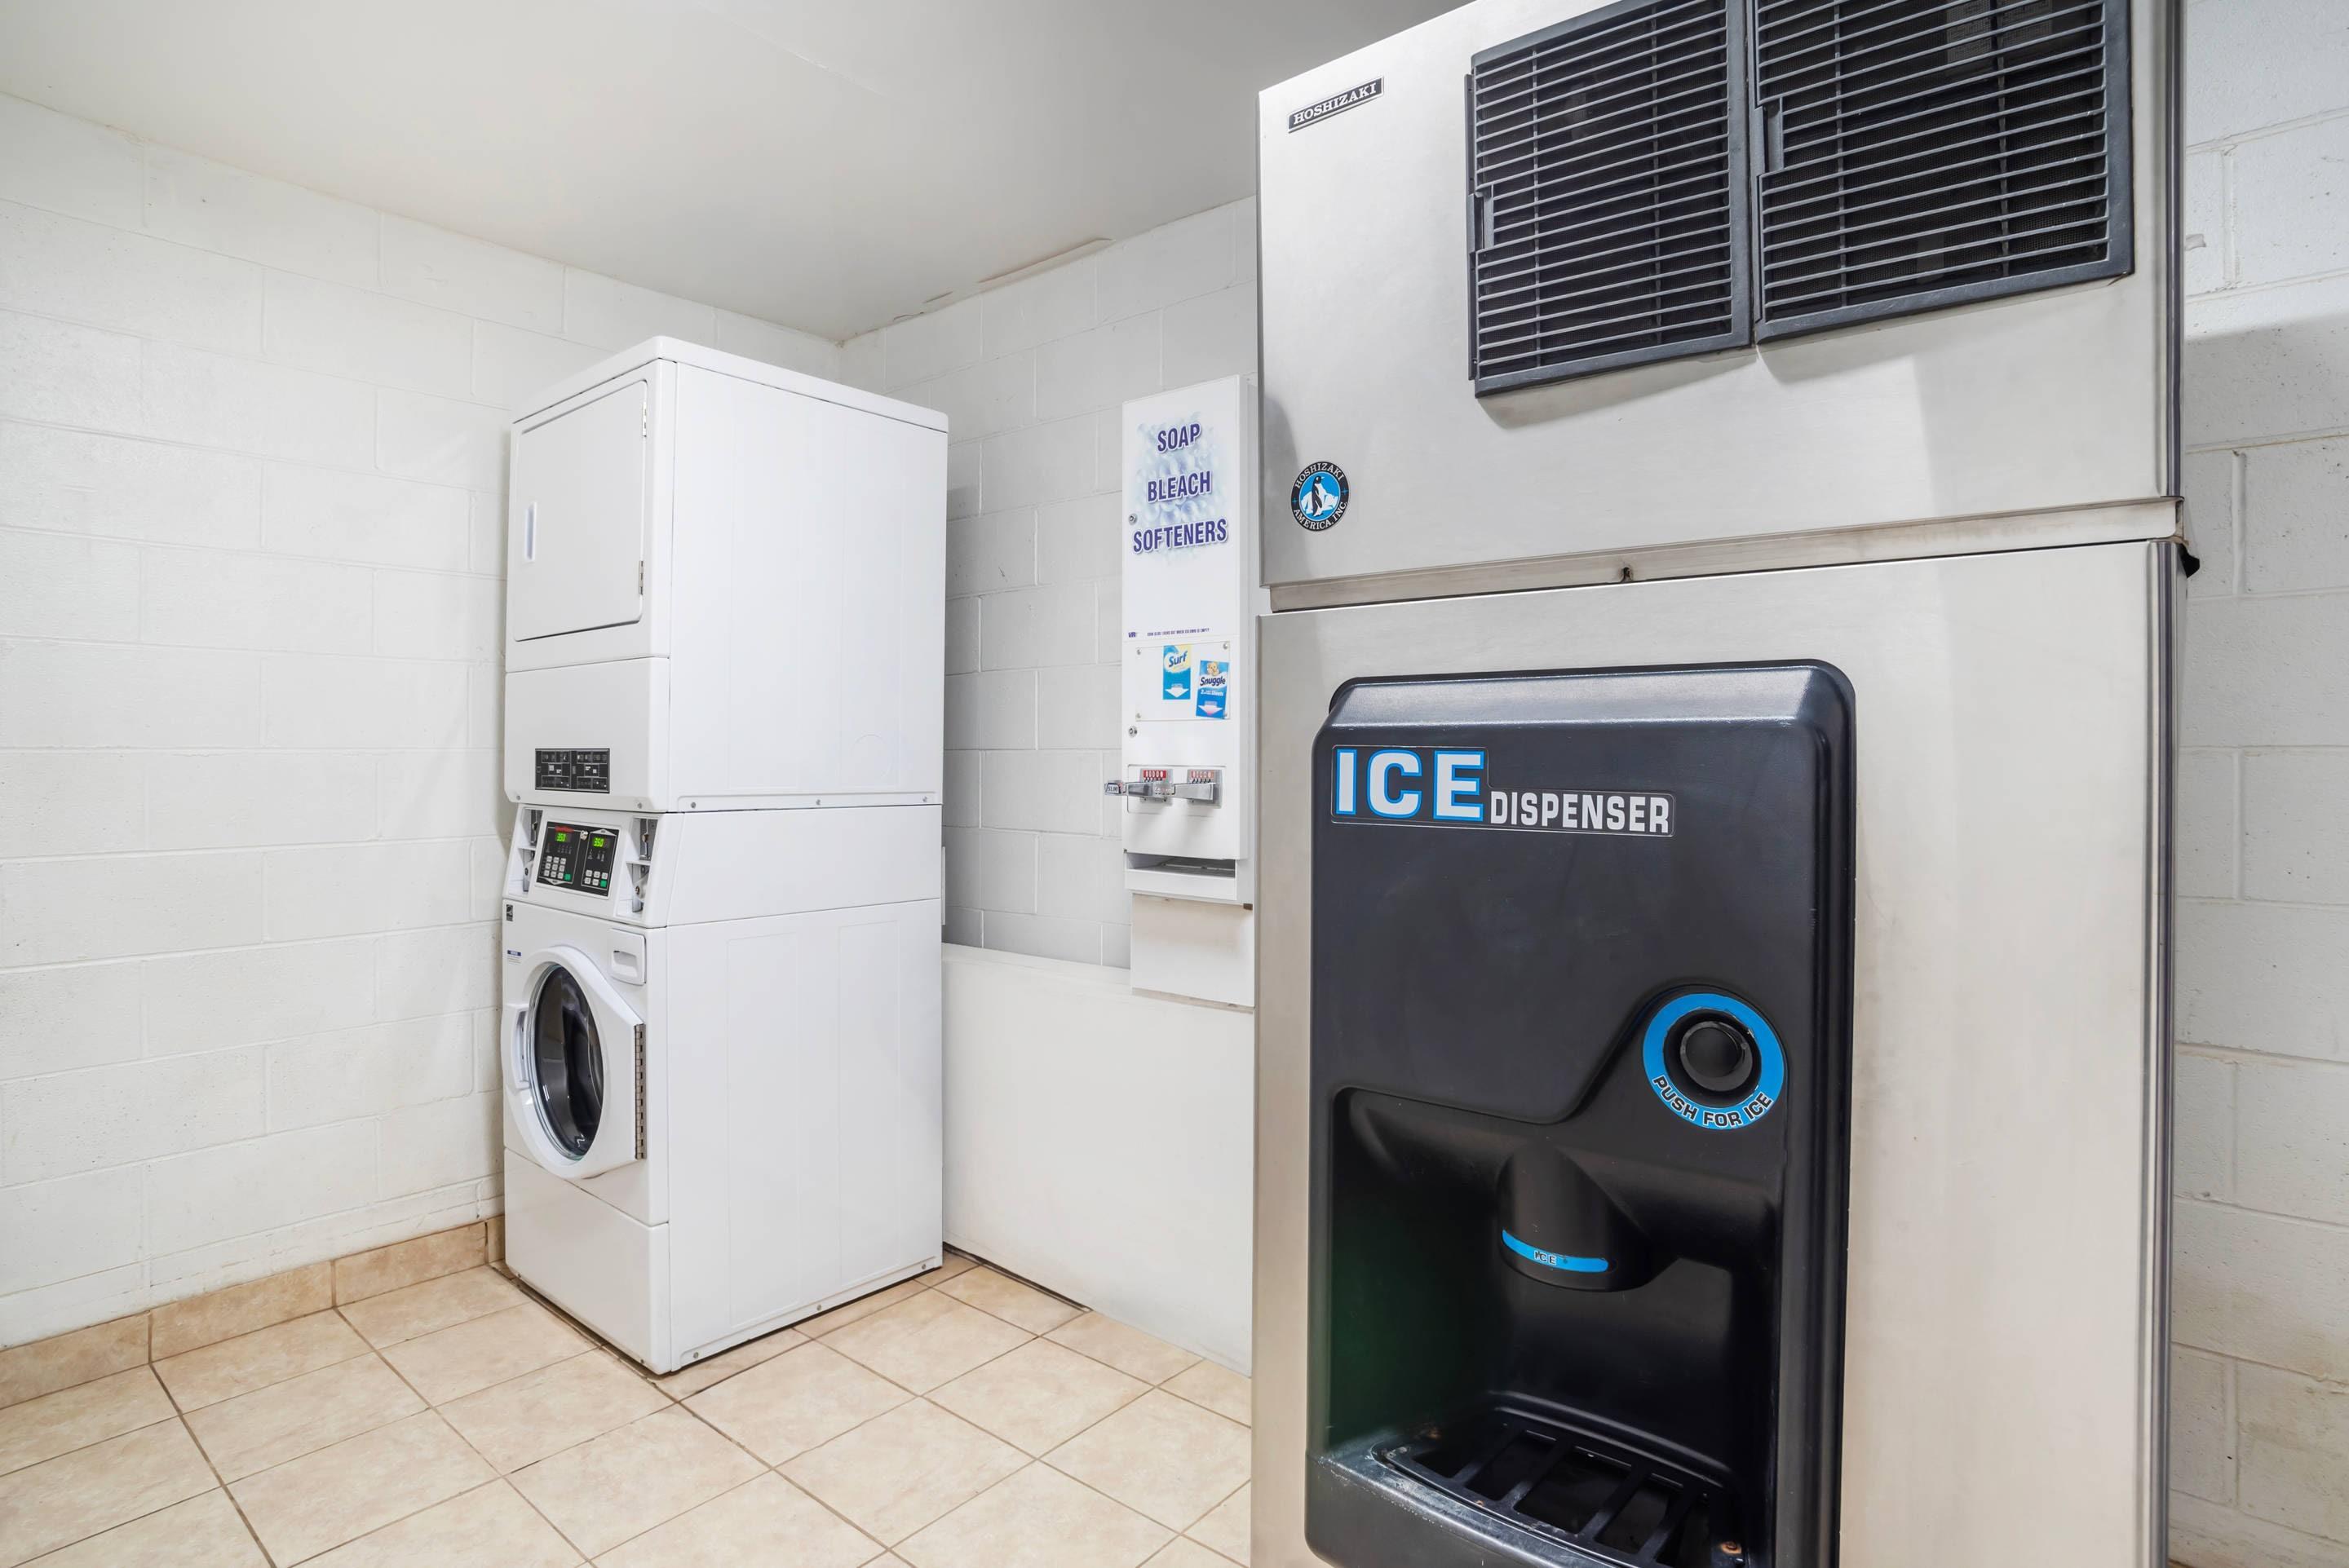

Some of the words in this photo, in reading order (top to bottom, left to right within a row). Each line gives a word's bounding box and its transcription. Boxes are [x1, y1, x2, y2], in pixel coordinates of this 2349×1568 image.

[1294, 82, 1377, 125] HOSHIZAKI
[1157, 423, 1200, 452] SOAP
[1148, 470, 1210, 502] BLEACH
[1294, 462, 1345, 489] HOSHIZAKI
[1133, 519, 1227, 553] SOFTENERS
[1168, 651, 1188, 668] Surf
[1200, 677, 1226, 686] Snuggle
[1336, 749, 1484, 821] ICE
[1490, 791, 1669, 833] DISPENSER
[1652, 1075, 1699, 1120] PUSH
[1703, 1111, 1743, 1128] FOR
[1744, 1092, 1774, 1120] ICE
[1534, 1250, 1557, 1265] ICE
